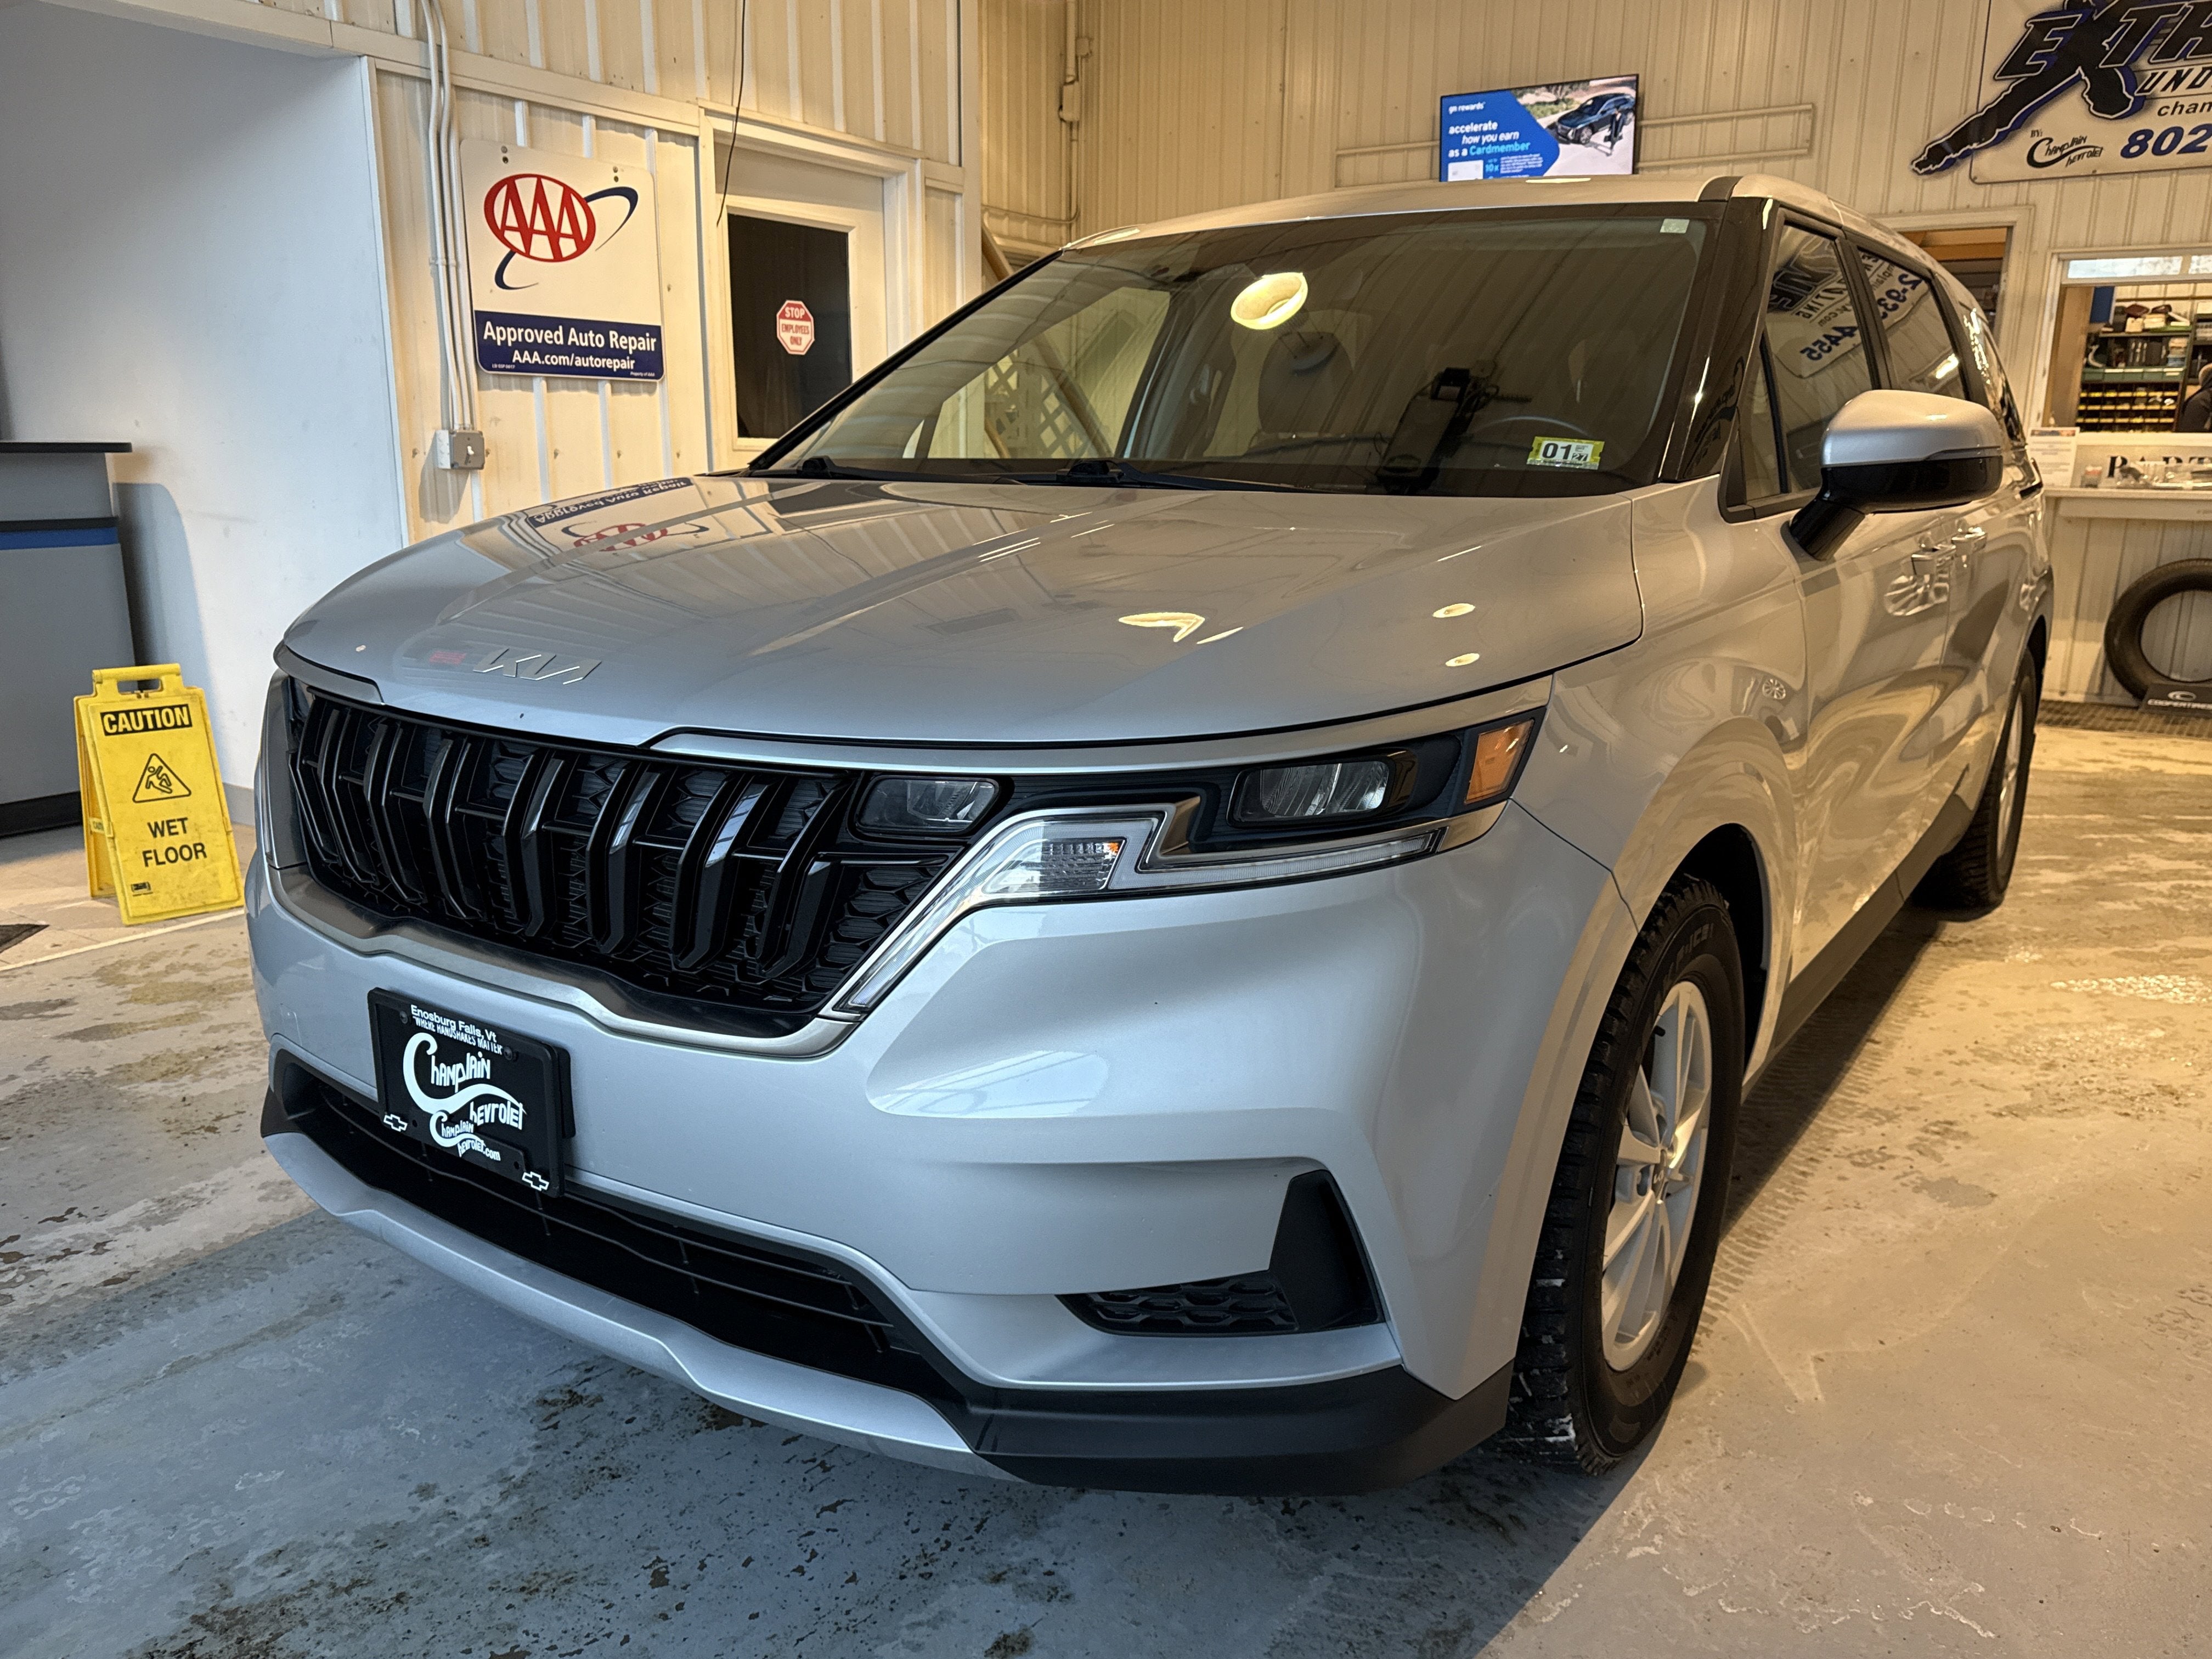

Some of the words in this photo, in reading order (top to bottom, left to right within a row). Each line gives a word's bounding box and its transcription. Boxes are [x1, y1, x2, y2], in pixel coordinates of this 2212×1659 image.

[1448, 120, 1498, 134] accelerate
[1462, 134, 1481, 145] how
[1481, 133, 1498, 145] you
[1498, 131, 1520, 142] earn
[2120, 123, 2212, 159] 802
[1448, 149, 1459, 157] as
[1461, 148, 1468, 156] a
[1469, 141, 1531, 156] Cardmember
[496, 175, 587, 262] AAA
[785, 307, 805, 318] STOP
[483, 321, 564, 346] Approved
[567, 328, 605, 347] Auto
[609, 330, 657, 354] Repair
[781, 324, 810, 335] EMPLOYEES
[789, 336, 803, 346] ONLY
[512, 350, 635, 371] AAA.com/autorepair
[1542, 442, 1572, 460] 01
[1572, 453, 1589, 461] 27
[103, 706, 190, 733] CAUTION
[147, 817, 189, 839] WET
[142, 843, 207, 867] FLOOR
[411, 1005, 456, 1031] Enosburg
[459, 1020, 484, 1040] Falls,
[485, 1029, 496, 1043] Vt
